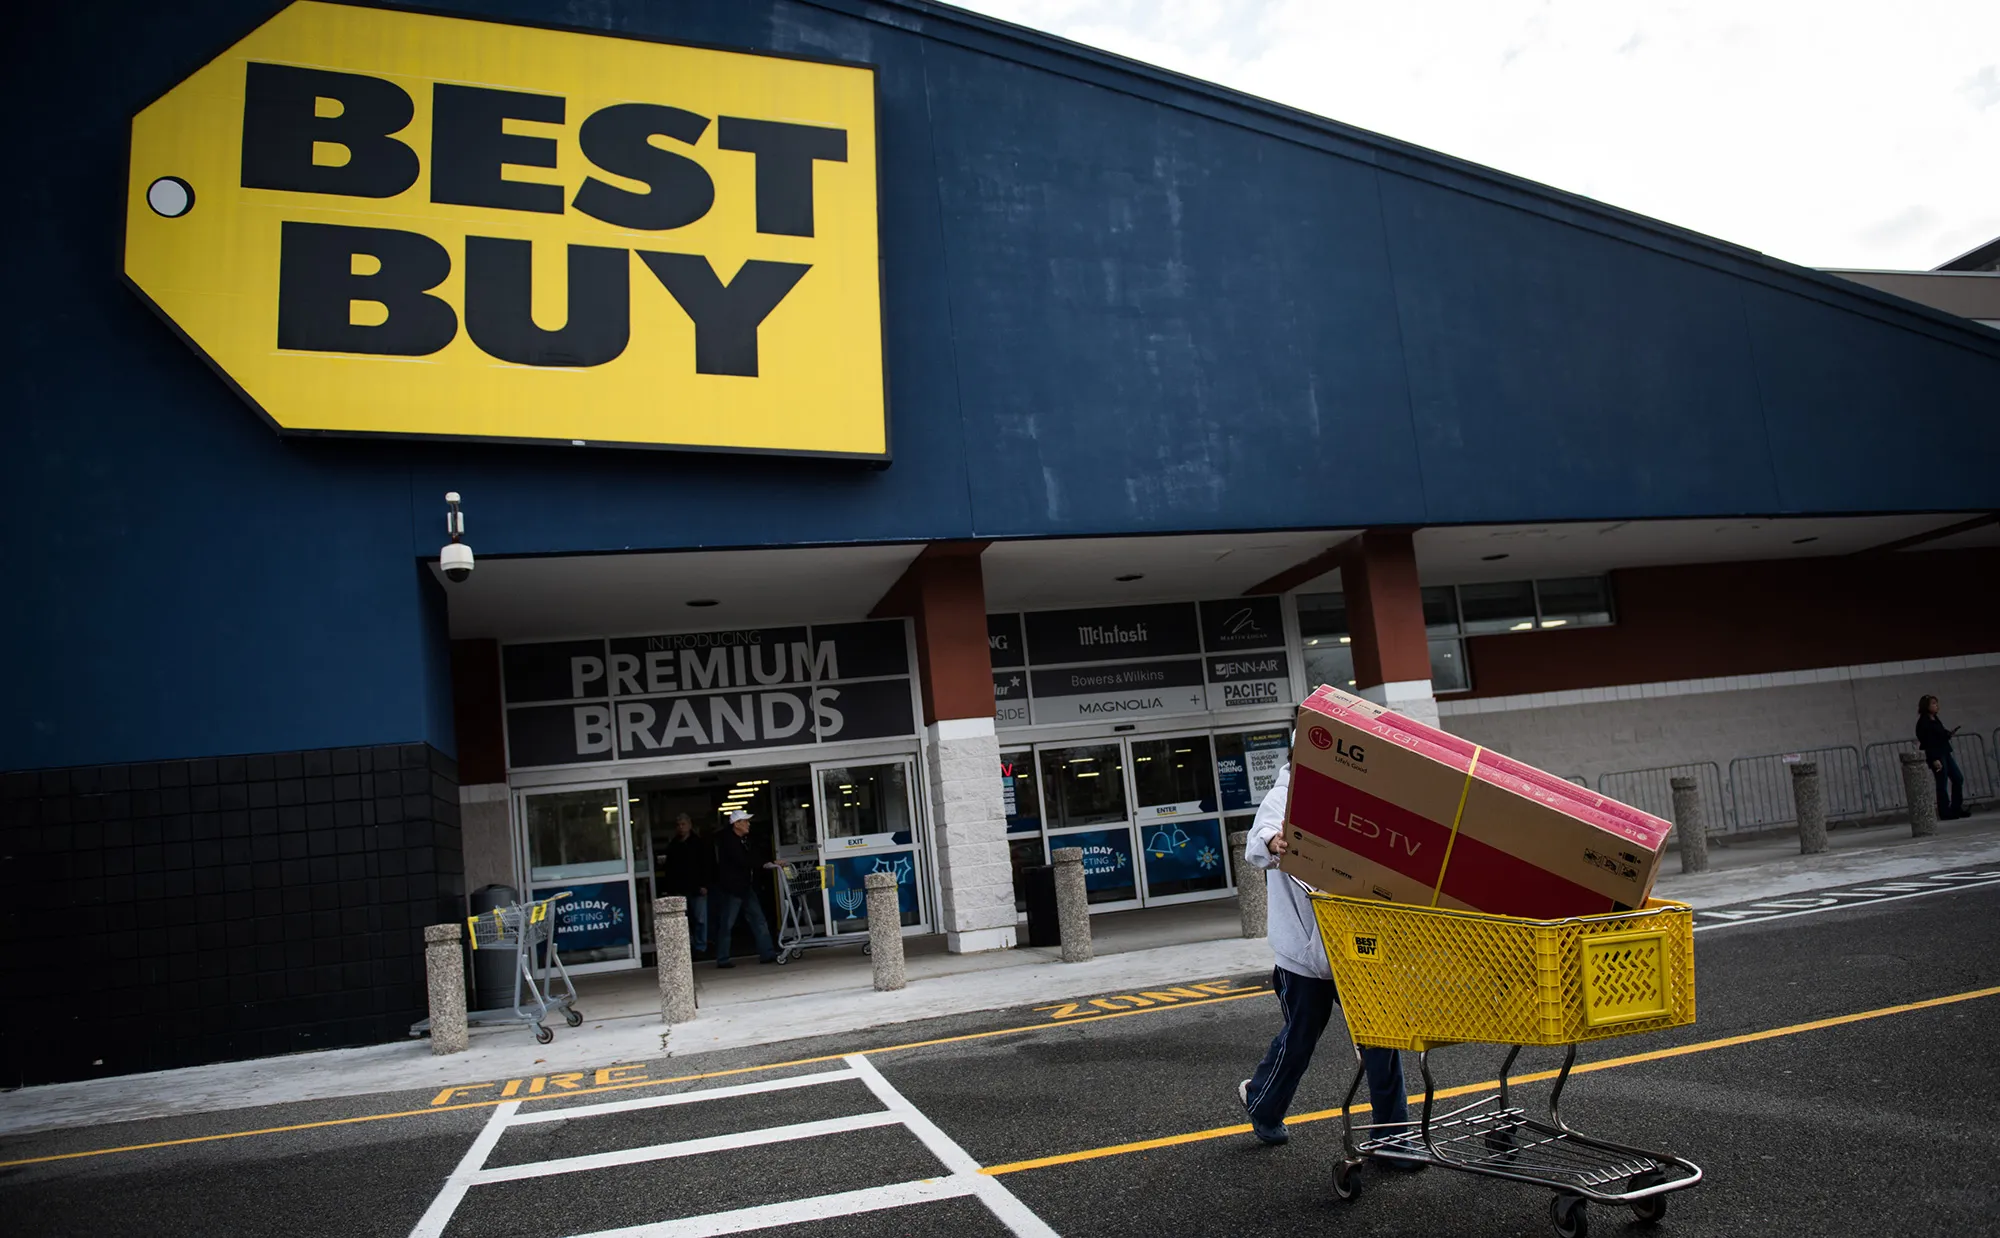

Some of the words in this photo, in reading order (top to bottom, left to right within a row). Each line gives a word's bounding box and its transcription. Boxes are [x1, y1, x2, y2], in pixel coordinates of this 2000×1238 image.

[240, 61, 848, 238] BEST
[277, 220, 814, 378] BUY
[647, 630, 762, 650] INTRODUCING
[988, 634, 1008, 650] NG
[1077, 622, 1148, 646] McIntosh
[570, 640, 839, 698] PREMIUM
[1225, 660, 1278, 679] JENN-AIR
[1071, 674, 1115, 687] Bowers
[1115, 673, 1123, 684] &
[1123, 670, 1164, 683] Wilkins
[1223, 682, 1277, 699] PACIFIC
[1079, 697, 1163, 714] MAGNOLIA
[573, 688, 844, 755] BRANDS
[1371, 725, 1391, 736] TV
[1393, 731, 1420, 747] LED
[1336, 738, 1365, 763] LG
[1218, 765, 1243, 774] HIRING
[1335, 755, 1350, 768] Life's
[1350, 762, 1368, 774] Good
[1156, 806, 1177, 814] ENTER
[1333, 806, 1380, 839] LED
[1385, 827, 1422, 857] TV
[1624, 827, 1637, 836] LG
[848, 838, 864, 846] EXIT
[1082, 846, 1114, 855] LIDAY
[1083, 856, 1109, 866] FTING
[1084, 867, 1094, 875] DE
[1095, 865, 1115, 874] EASY
[1694, 871, 2000, 923] ADING
[556, 900, 609, 915] HOLIDAY
[562, 912, 604, 924] GIFTING
[558, 924, 584, 934] MADE
[587, 922, 611, 931] EASY
[1355, 936, 1377, 946] BEST
[1357, 946, 1377, 955] BUY
[431, 1064, 649, 1106] FIRE
[1031, 979, 1263, 1019] ZONE
